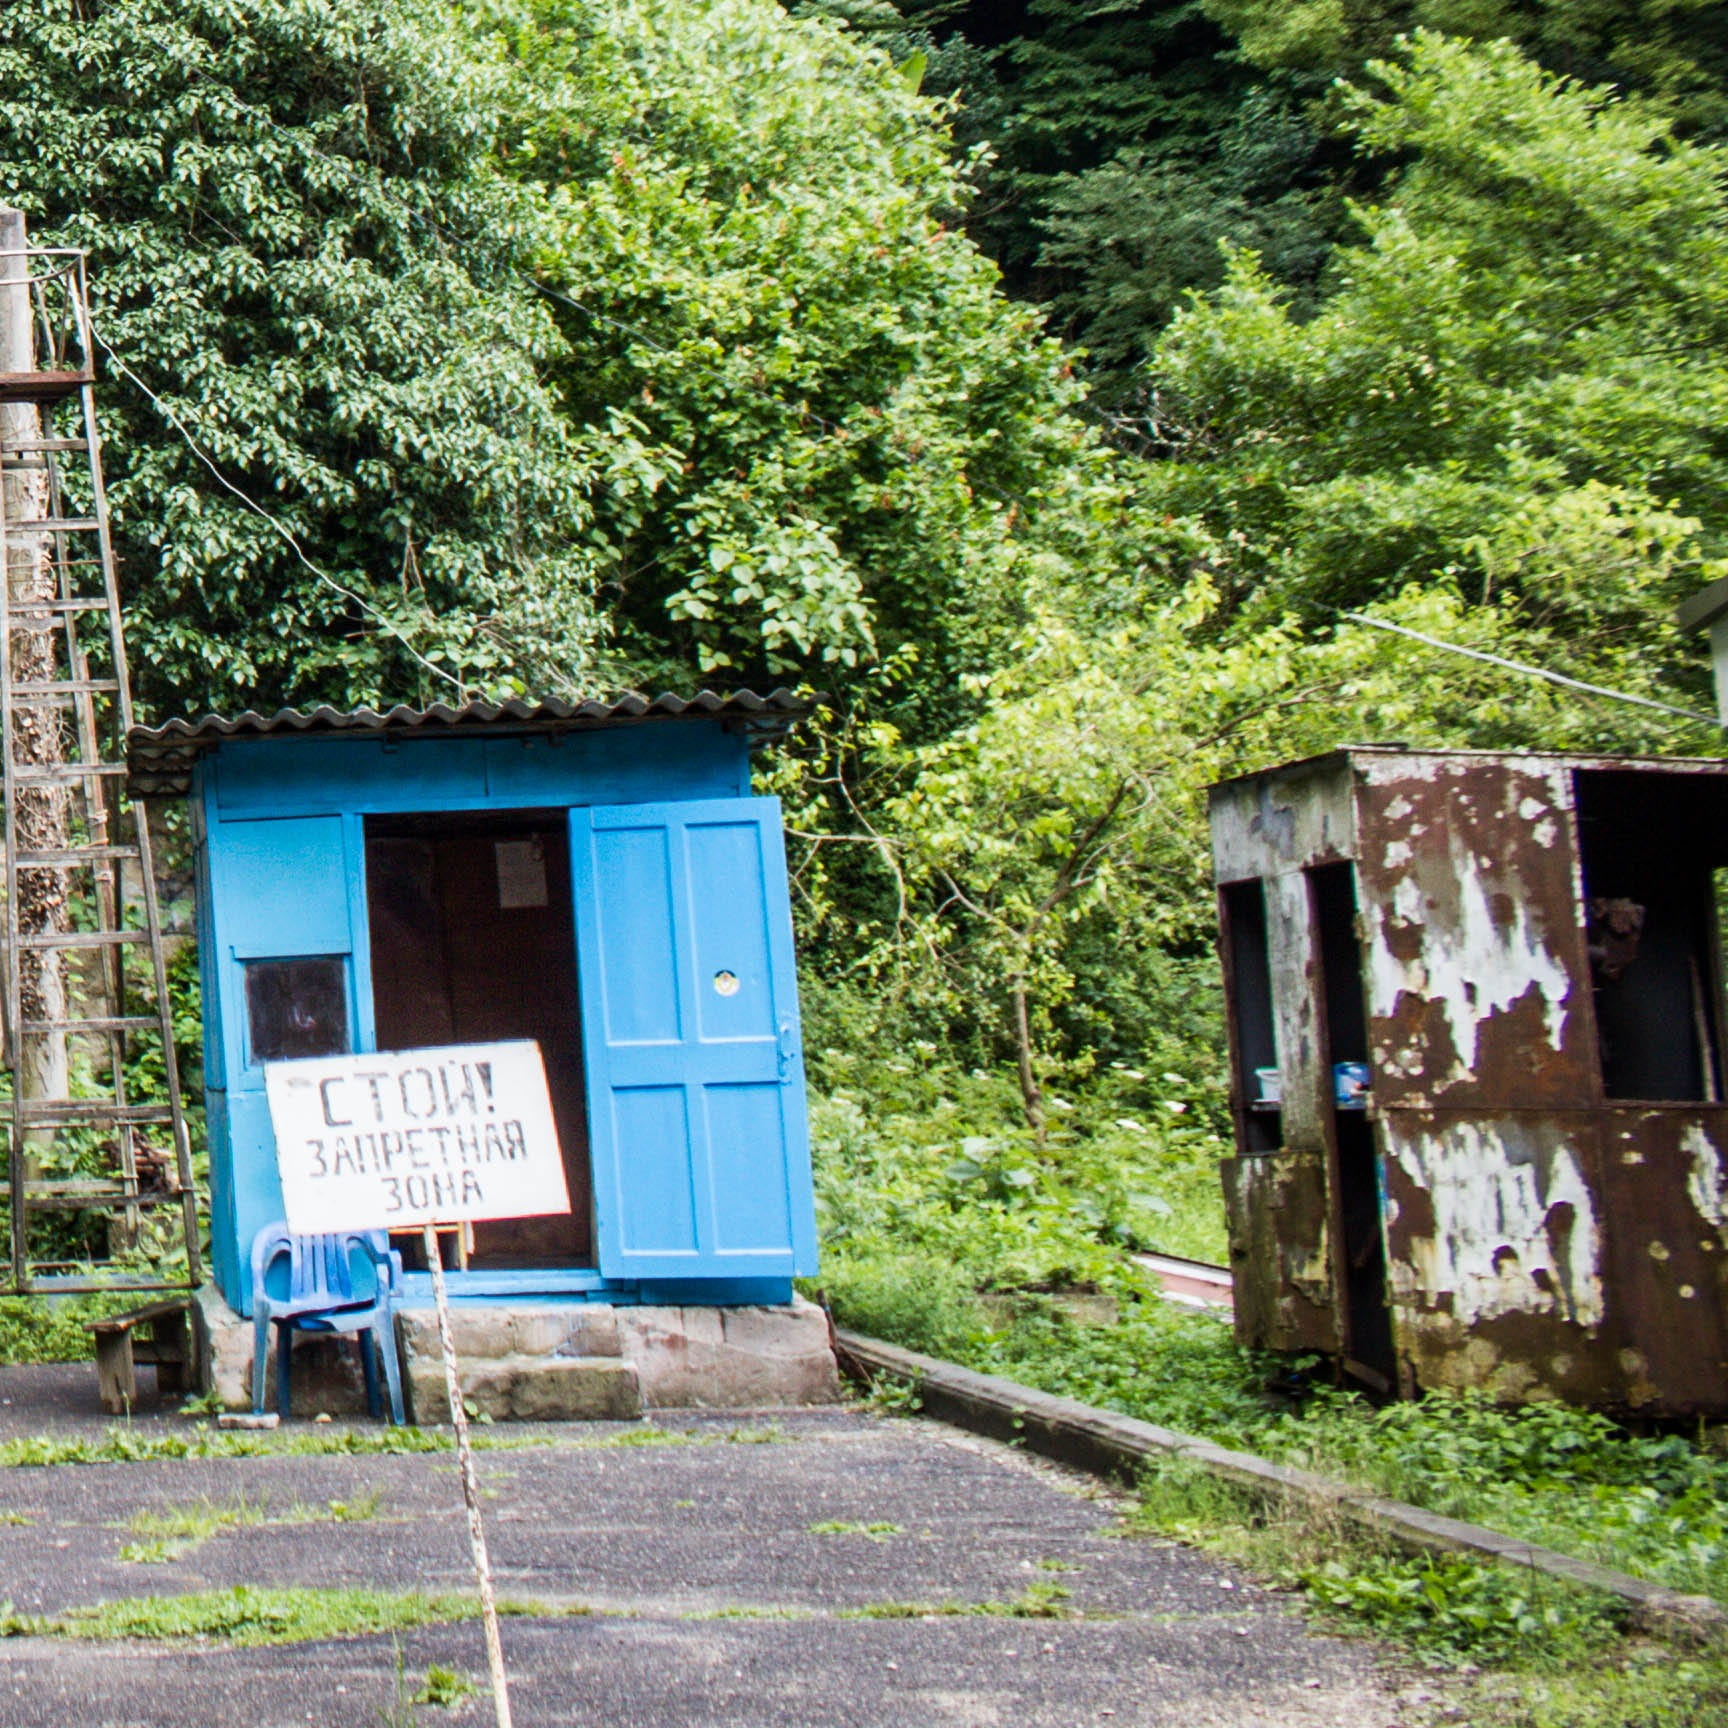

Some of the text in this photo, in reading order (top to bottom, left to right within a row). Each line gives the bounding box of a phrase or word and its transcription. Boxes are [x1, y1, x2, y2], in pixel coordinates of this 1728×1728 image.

[319, 1060, 495, 1127] СТОЙ!
[305, 1119, 528, 1177] ЗАПРЕТНАЯ
[381, 1169, 483, 1212] ЗОНА
